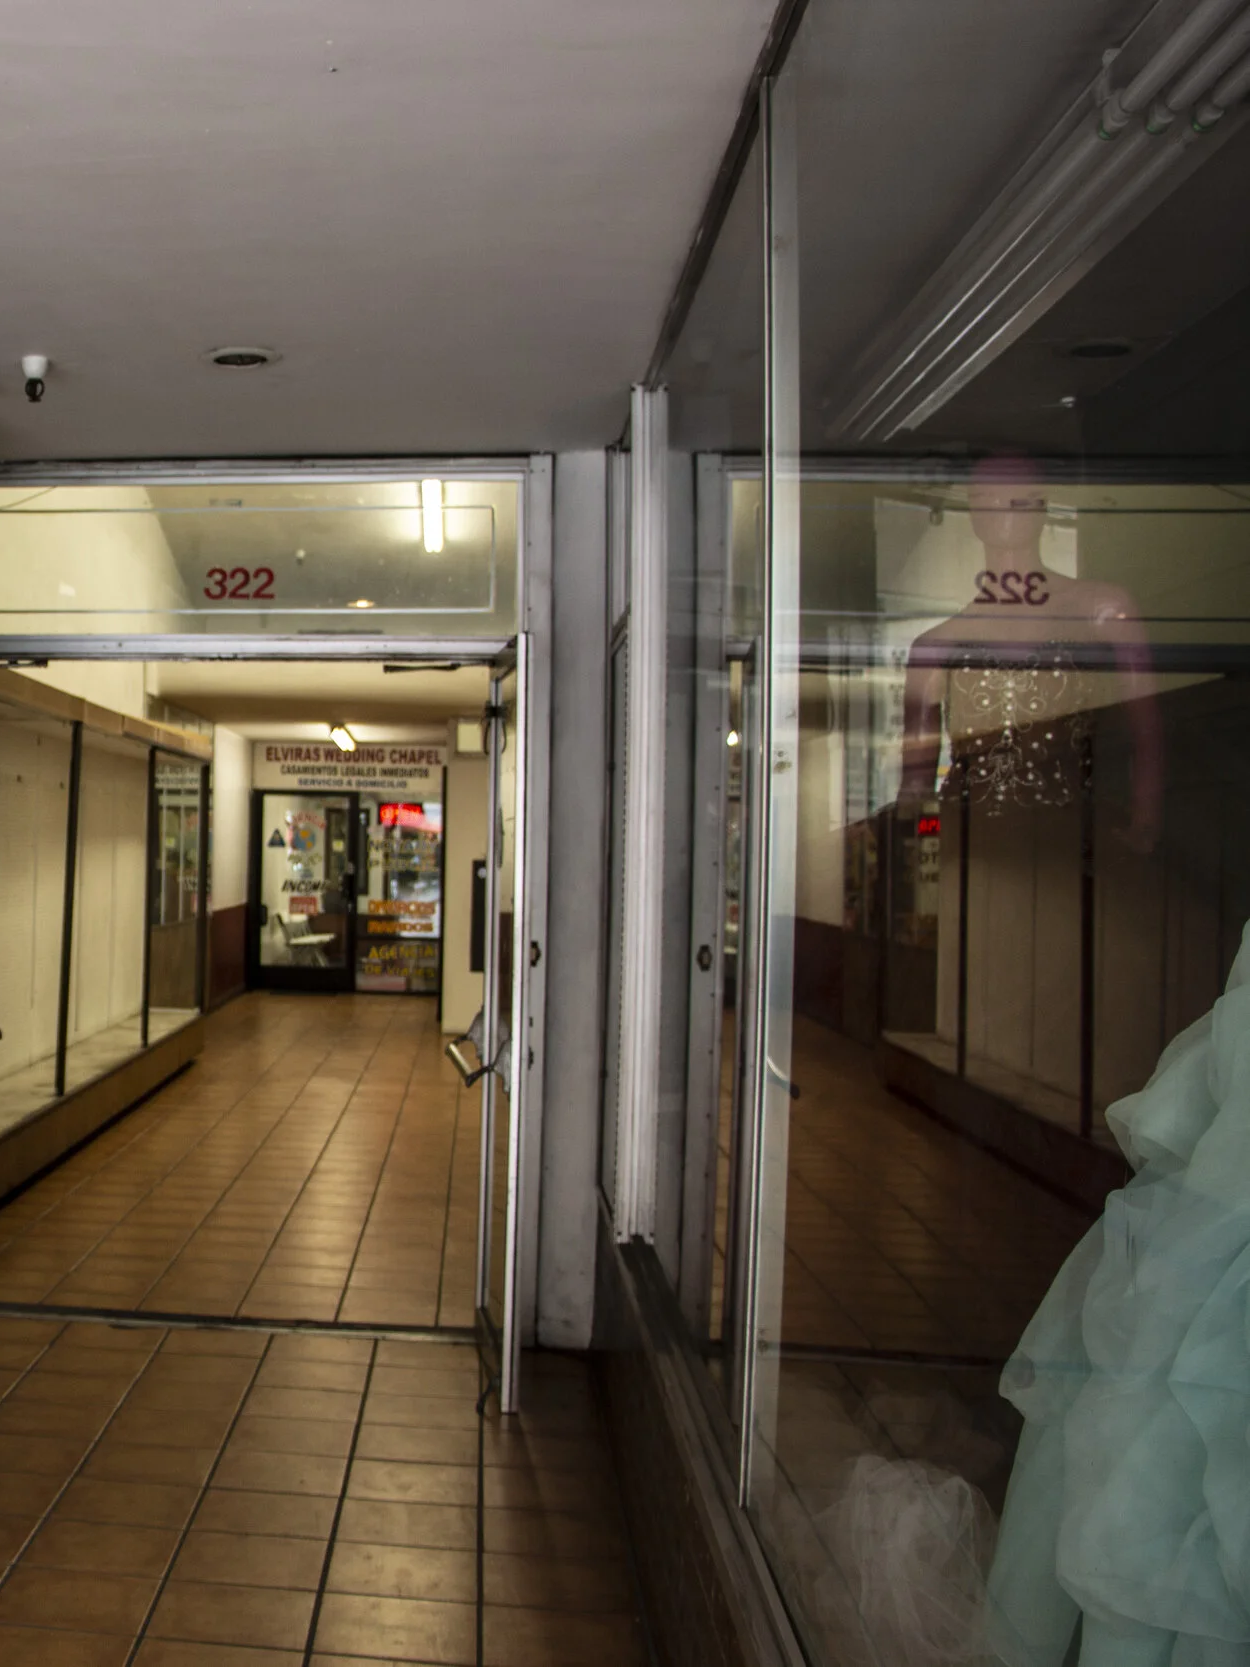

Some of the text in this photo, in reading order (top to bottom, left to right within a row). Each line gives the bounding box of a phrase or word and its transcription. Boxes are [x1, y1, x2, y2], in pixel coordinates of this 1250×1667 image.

[202, 566, 276, 600] 322
[265, 746, 442, 766] ELVIRAS WEDDING CHAPEL
[280, 764, 430, 779] CASAMIENTOS LEGALES INMEDIATOS
[297, 778, 344, 787] SERVICIO
[354, 779, 408, 789] DOMICILIO
